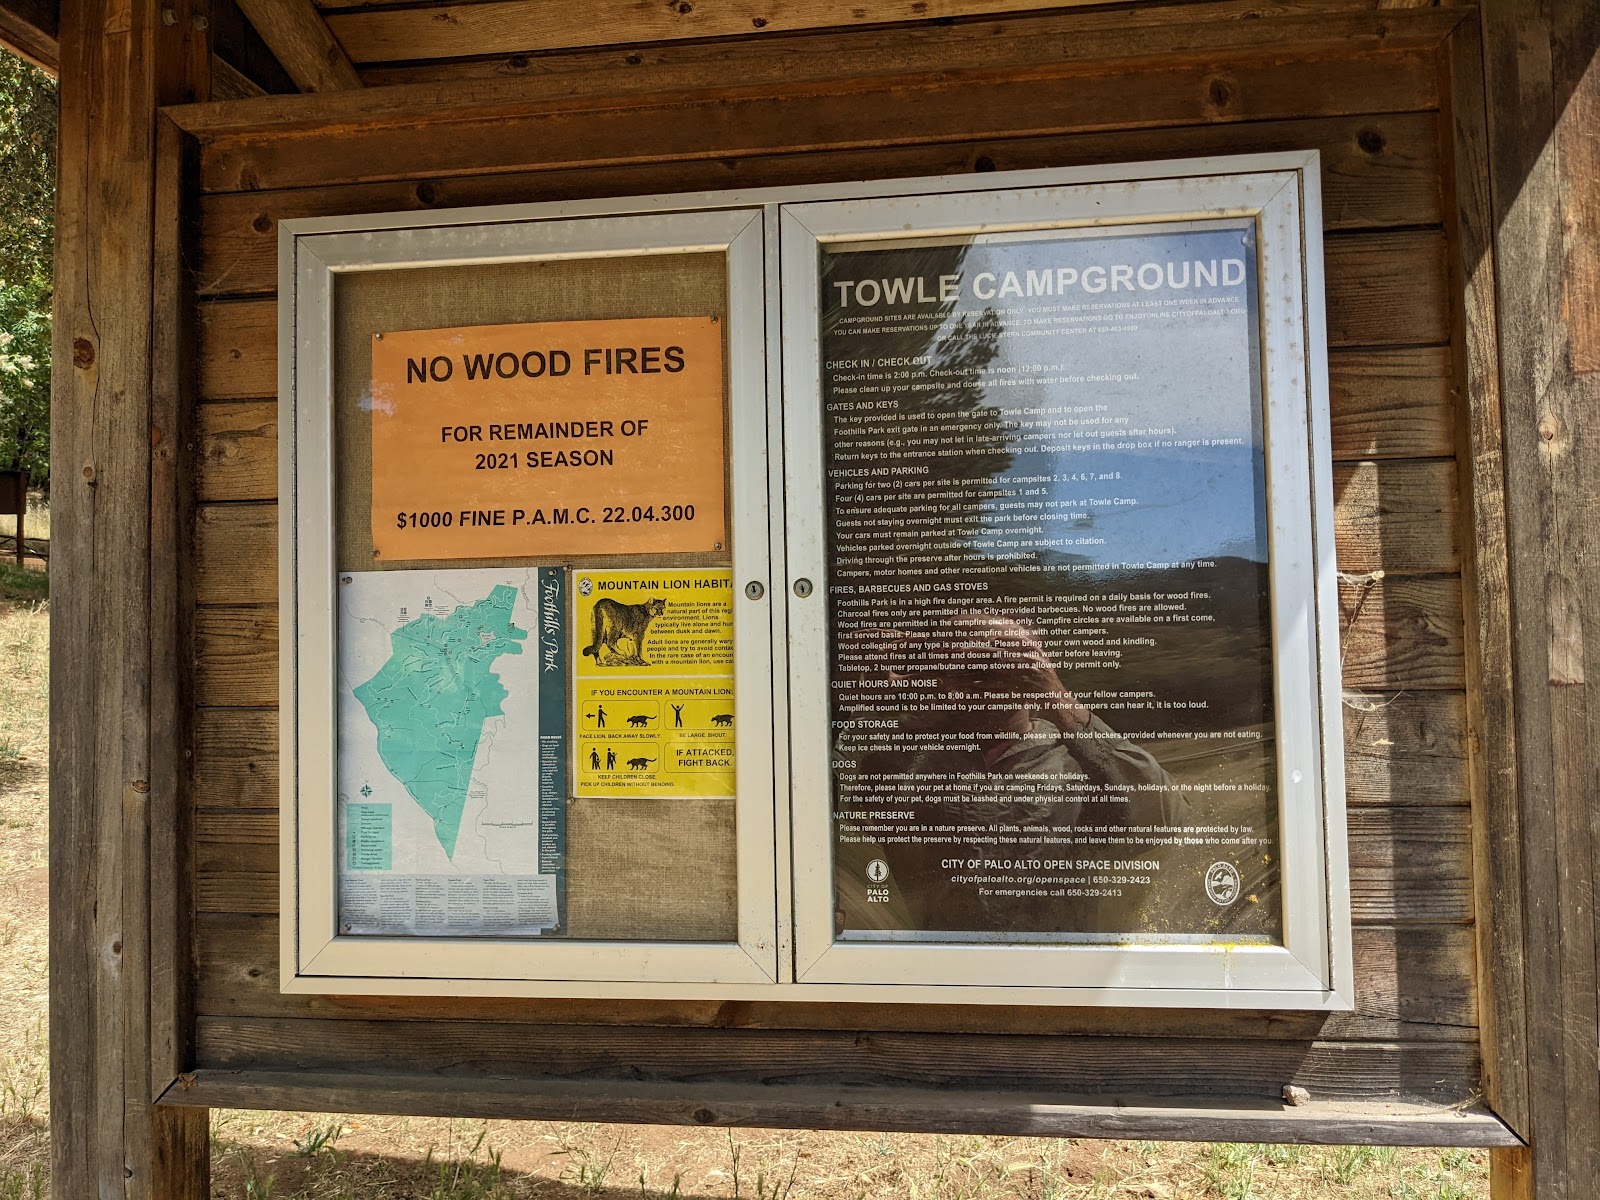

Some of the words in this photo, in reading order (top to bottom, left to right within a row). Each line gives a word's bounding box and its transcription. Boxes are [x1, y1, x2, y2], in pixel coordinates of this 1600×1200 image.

[834, 274, 960, 308] TOWLE
[973, 259, 1246, 300] CAMPGROUND
[839, 316, 882, 324] CAMPGROUND
[882, 324, 928, 333] RESERVATIONS
[406, 355, 453, 384] NO
[464, 350, 571, 381] WOOD
[584, 346, 686, 376] FIRES
[826, 359, 858, 369] CHECK
[861, 359, 869, 368] IN
[877, 357, 909, 367] CHECK
[912, 356, 932, 365] OUT
[833, 372, 865, 382] Check-in
[867, 371, 883, 380] time
[885, 371, 892, 379] is
[894, 370, 909, 378] 2:00
[911, 371, 928, 380] p.m.
[929, 367, 968, 377] Check-out
[970, 366, 985, 375] time
[988, 366, 995, 374] is
[1018, 363, 1042, 374] (12:00
[827, 402, 854, 411] GATES
[856, 401, 874, 410] AND
[876, 400, 899, 409] KEYS
[442, 426, 483, 443] FOR
[489, 420, 614, 441] REMAINDER
[621, 419, 649, 437] OF
[475, 453, 519, 470] 2021
[527, 449, 613, 468] SEASON
[828, 468, 869, 477] VEHICLES
[871, 467, 889, 476] AND
[891, 466, 929, 475] PARKING
[836, 494, 852, 503] Four
[854, 494, 864, 504] (4)
[884, 494, 896, 503] per
[898, 492, 911, 500] site
[927, 490, 963, 501] permitted
[965, 489, 976, 498] for
[978, 488, 1016, 499] campsites
[1018, 488, 1023, 496] 1
[1025, 487, 1039, 495] and
[1042, 487, 1049, 495] 5.
[397, 511, 453, 530] $1000
[459, 510, 505, 527] FINE
[512, 507, 595, 526] P.A.M.C.
[602, 504, 695, 523] 22.04.300
[836, 531, 852, 539] Your
[873, 530, 891, 538] must
[893, 529, 919, 538] remain
[921, 529, 946, 539] parked
[947, 528, 955, 536] at
[957, 528, 979, 536] Towle
[981, 527, 1003, 537] Camp
[1005, 526, 1044, 537] overnight.
[598, 581, 658, 590] MOUNTAIN
[664, 580, 690, 589] LION
[694, 579, 732, 588] HABIT
[830, 585, 856, 595] FIRES,
[859, 584, 911, 593] BARBECUES
[913, 584, 931, 592] AND
[933, 583, 951, 592] GAS
[954, 582, 988, 591] STOVES
[541, 579, 560, 635] Foothills
[837, 609, 870, 618] Charcoal
[872, 609, 889, 617] fires
[890, 608, 907, 619] only
[922, 607, 958, 618] permitted
[960, 607, 967, 615] in
[970, 607, 982, 615] the
[984, 606, 1035, 617] City-provided
[1037, 605, 1080, 614] barbecues.
[1082, 605, 1094, 613] No
[1095, 604, 1117, 612] wood
[1119, 604, 1137, 612] fires
[1153, 603, 1186, 611] allowed.
[541, 636, 558, 674] Park
[831, 680, 856, 688] QUIET
[859, 680, 889, 688] HOURS
[891, 679, 909, 688] AND
[911, 679, 937, 688] NOISE
[832, 720, 855, 728] FOOD
[858, 720, 898, 728] STORAGE
[838, 744, 856, 753] Keep
[869, 743, 892, 751] chests
[894, 743, 900, 751] in
[902, 745, 918, 753] your
[919, 743, 944, 751] vehicle
[946, 743, 981, 753] overnight.
[832, 760, 856, 768] DOGS
[833, 811, 866, 819] NATURE
[869, 811, 915, 819] PRESERVE
[942, 859, 964, 869] CITY
[967, 859, 981, 869] OF
[984, 860, 1011, 869] PALO
[1014, 860, 1040, 869] ALTO
[1044, 860, 1072, 870] OPEN
[1076, 860, 1110, 870] SPACE
[1114, 860, 1160, 870] DIVISION
[951, 875, 1085, 885] cityofpaloalto.org/openspace
[979, 888, 993, 896] For
[995, 888, 1048, 898] emergencies
[1050, 888, 1065, 896] call
[1067, 888, 1122, 897] 650-329-2413
